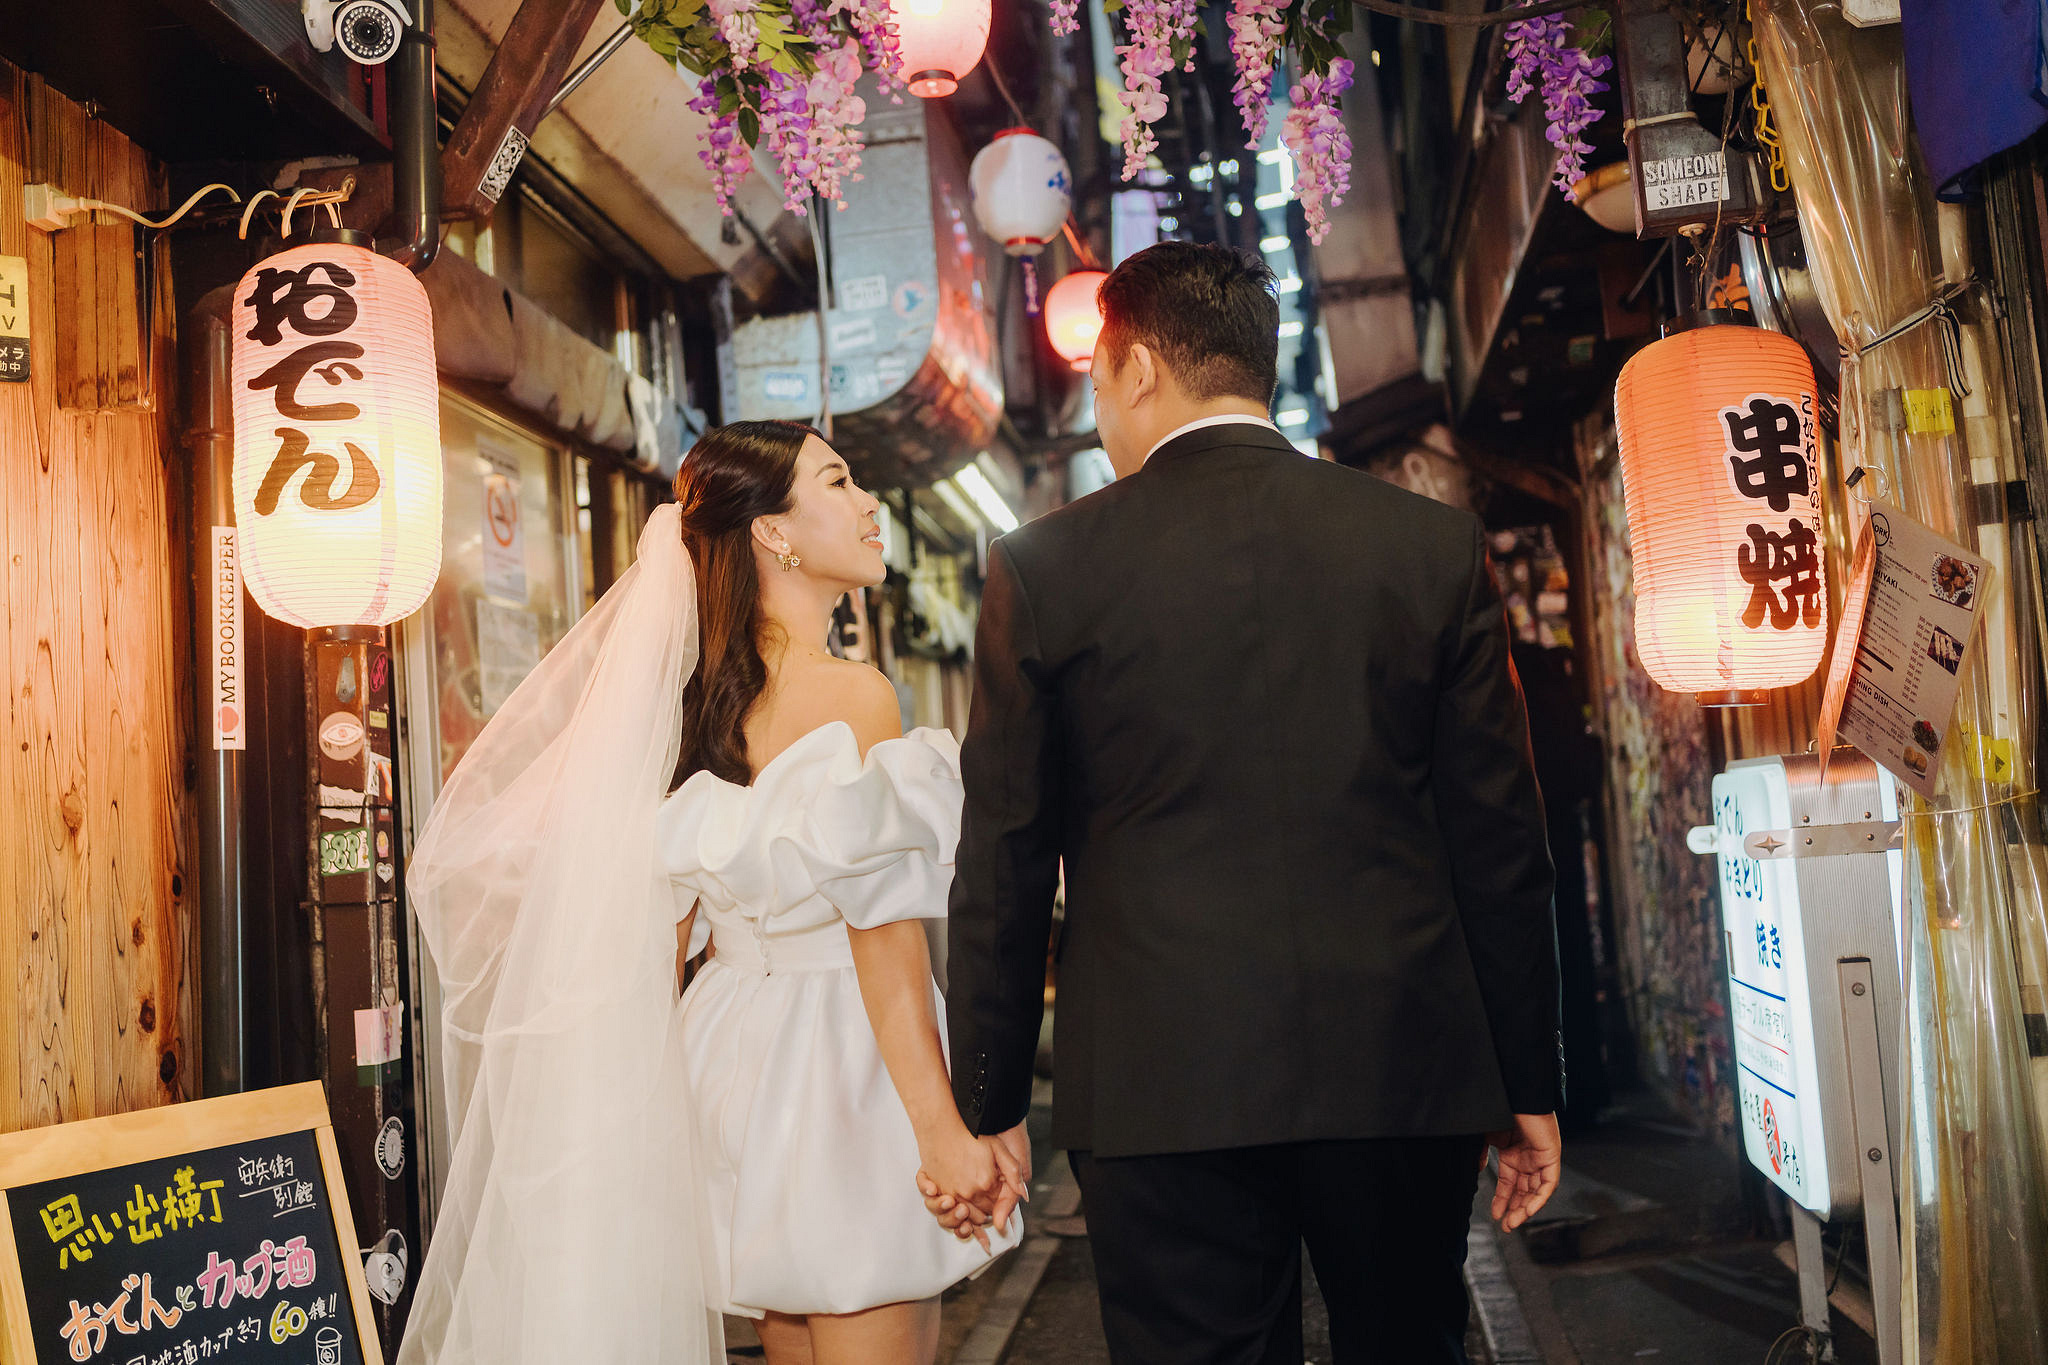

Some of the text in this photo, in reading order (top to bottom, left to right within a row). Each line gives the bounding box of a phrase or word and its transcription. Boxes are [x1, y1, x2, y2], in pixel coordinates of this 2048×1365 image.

[243, 261, 381, 517] おでん
[1724, 398, 1822, 631] 串焼
[1873, 524, 1888, 539] ORK
[1874, 566, 1898, 588] HIYAKI
[219, 535, 235, 668] BOOKKEEPER
[220, 671, 235, 703] MY
[1874, 692, 1889, 708] DISH
[273, 1180, 314, 1209] 別館
[39, 1164, 225, 1270] 思い出横丁
